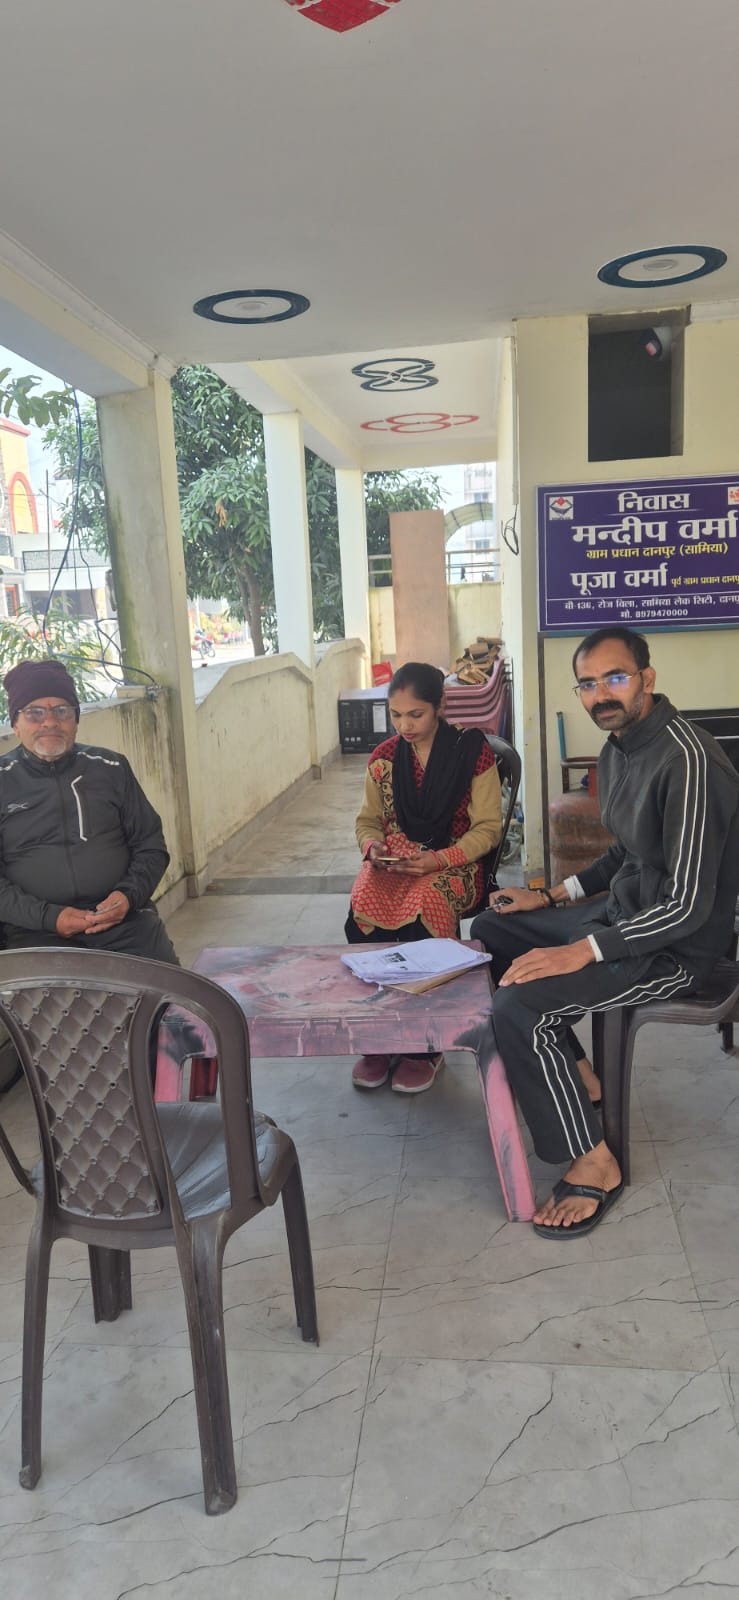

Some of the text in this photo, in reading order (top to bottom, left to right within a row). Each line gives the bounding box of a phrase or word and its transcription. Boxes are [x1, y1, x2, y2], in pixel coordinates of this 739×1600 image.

[617, 491, 690, 512] निवास
[571, 509, 738, 545] मन्दीप वर्मा
[586, 541, 728, 559] ग्राम प्रधान दानपुर (सामिया)
[569, 562, 669, 596] पूजा वर्मा
[674, 596, 691, 606] लेक
[635, 609, 689, 618] 8979470000
